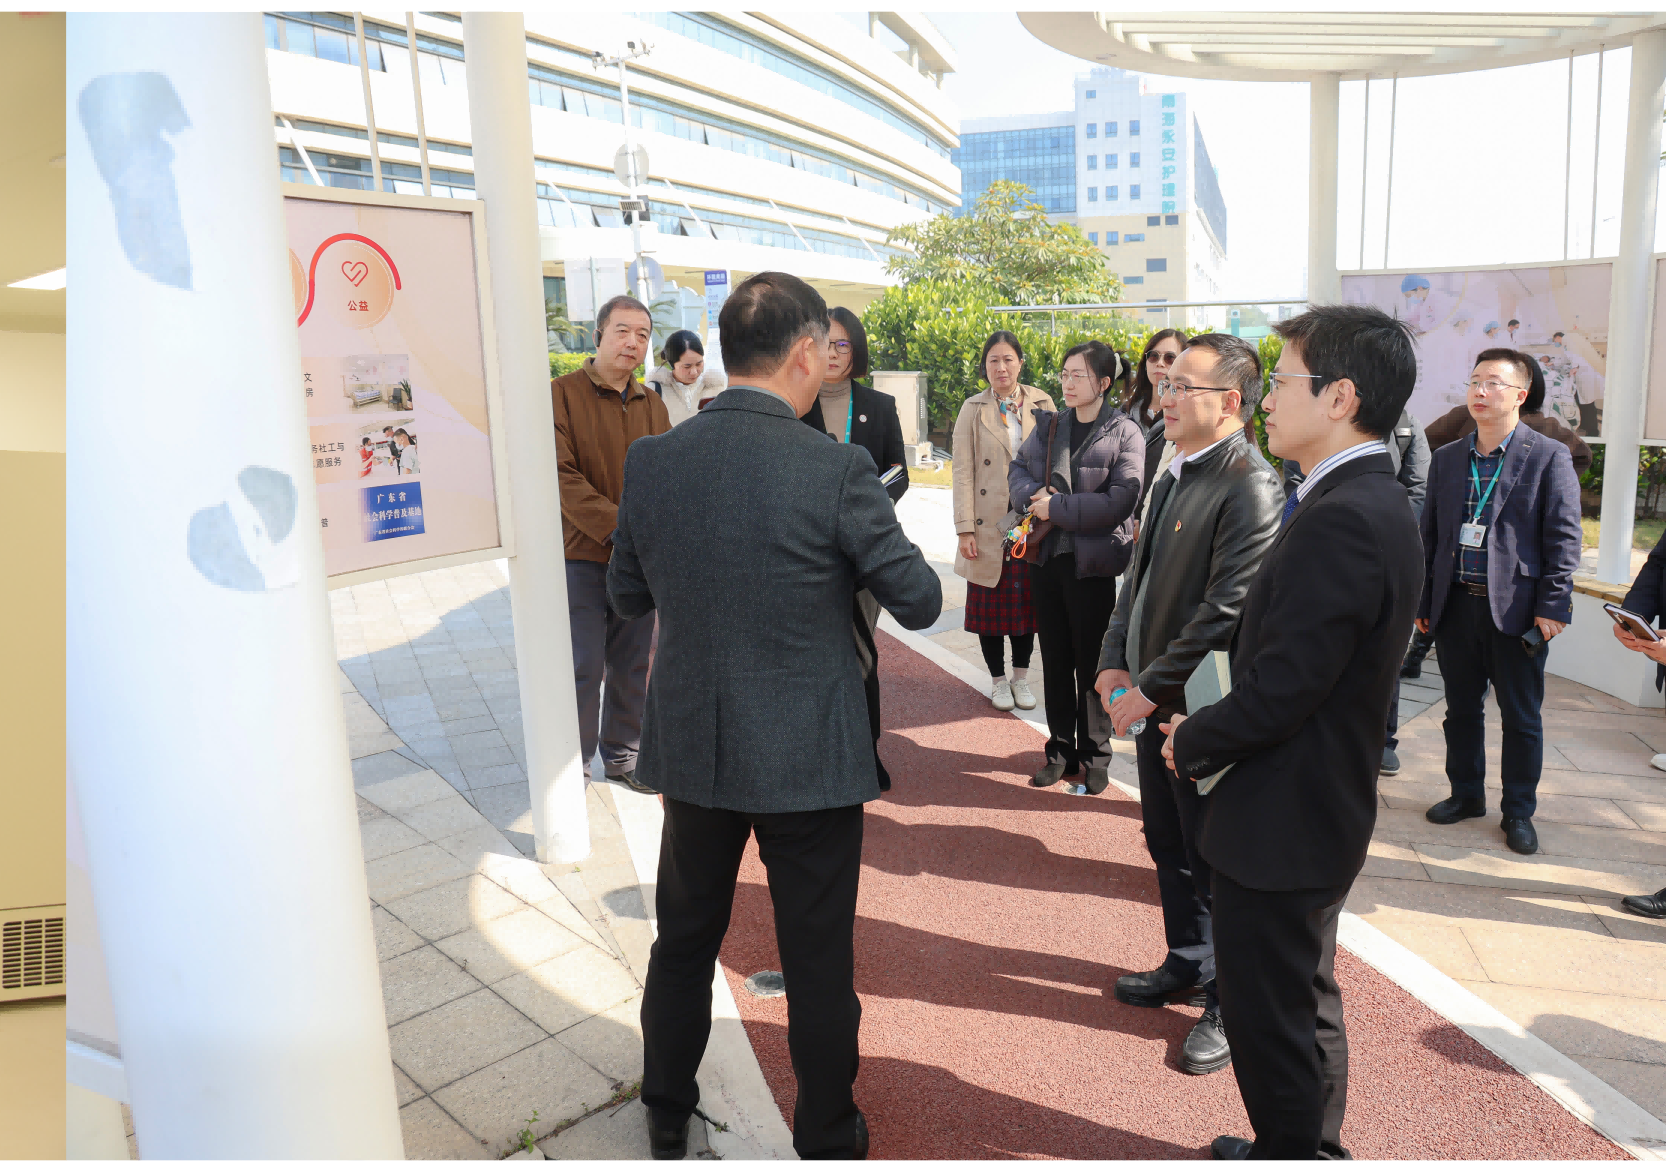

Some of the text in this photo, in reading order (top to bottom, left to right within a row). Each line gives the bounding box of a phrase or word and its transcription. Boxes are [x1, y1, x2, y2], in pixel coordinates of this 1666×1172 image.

[347, 300, 369, 311] 公益
[313, 457, 341, 468] 愿服务
[377, 491, 406, 504] 广东省
